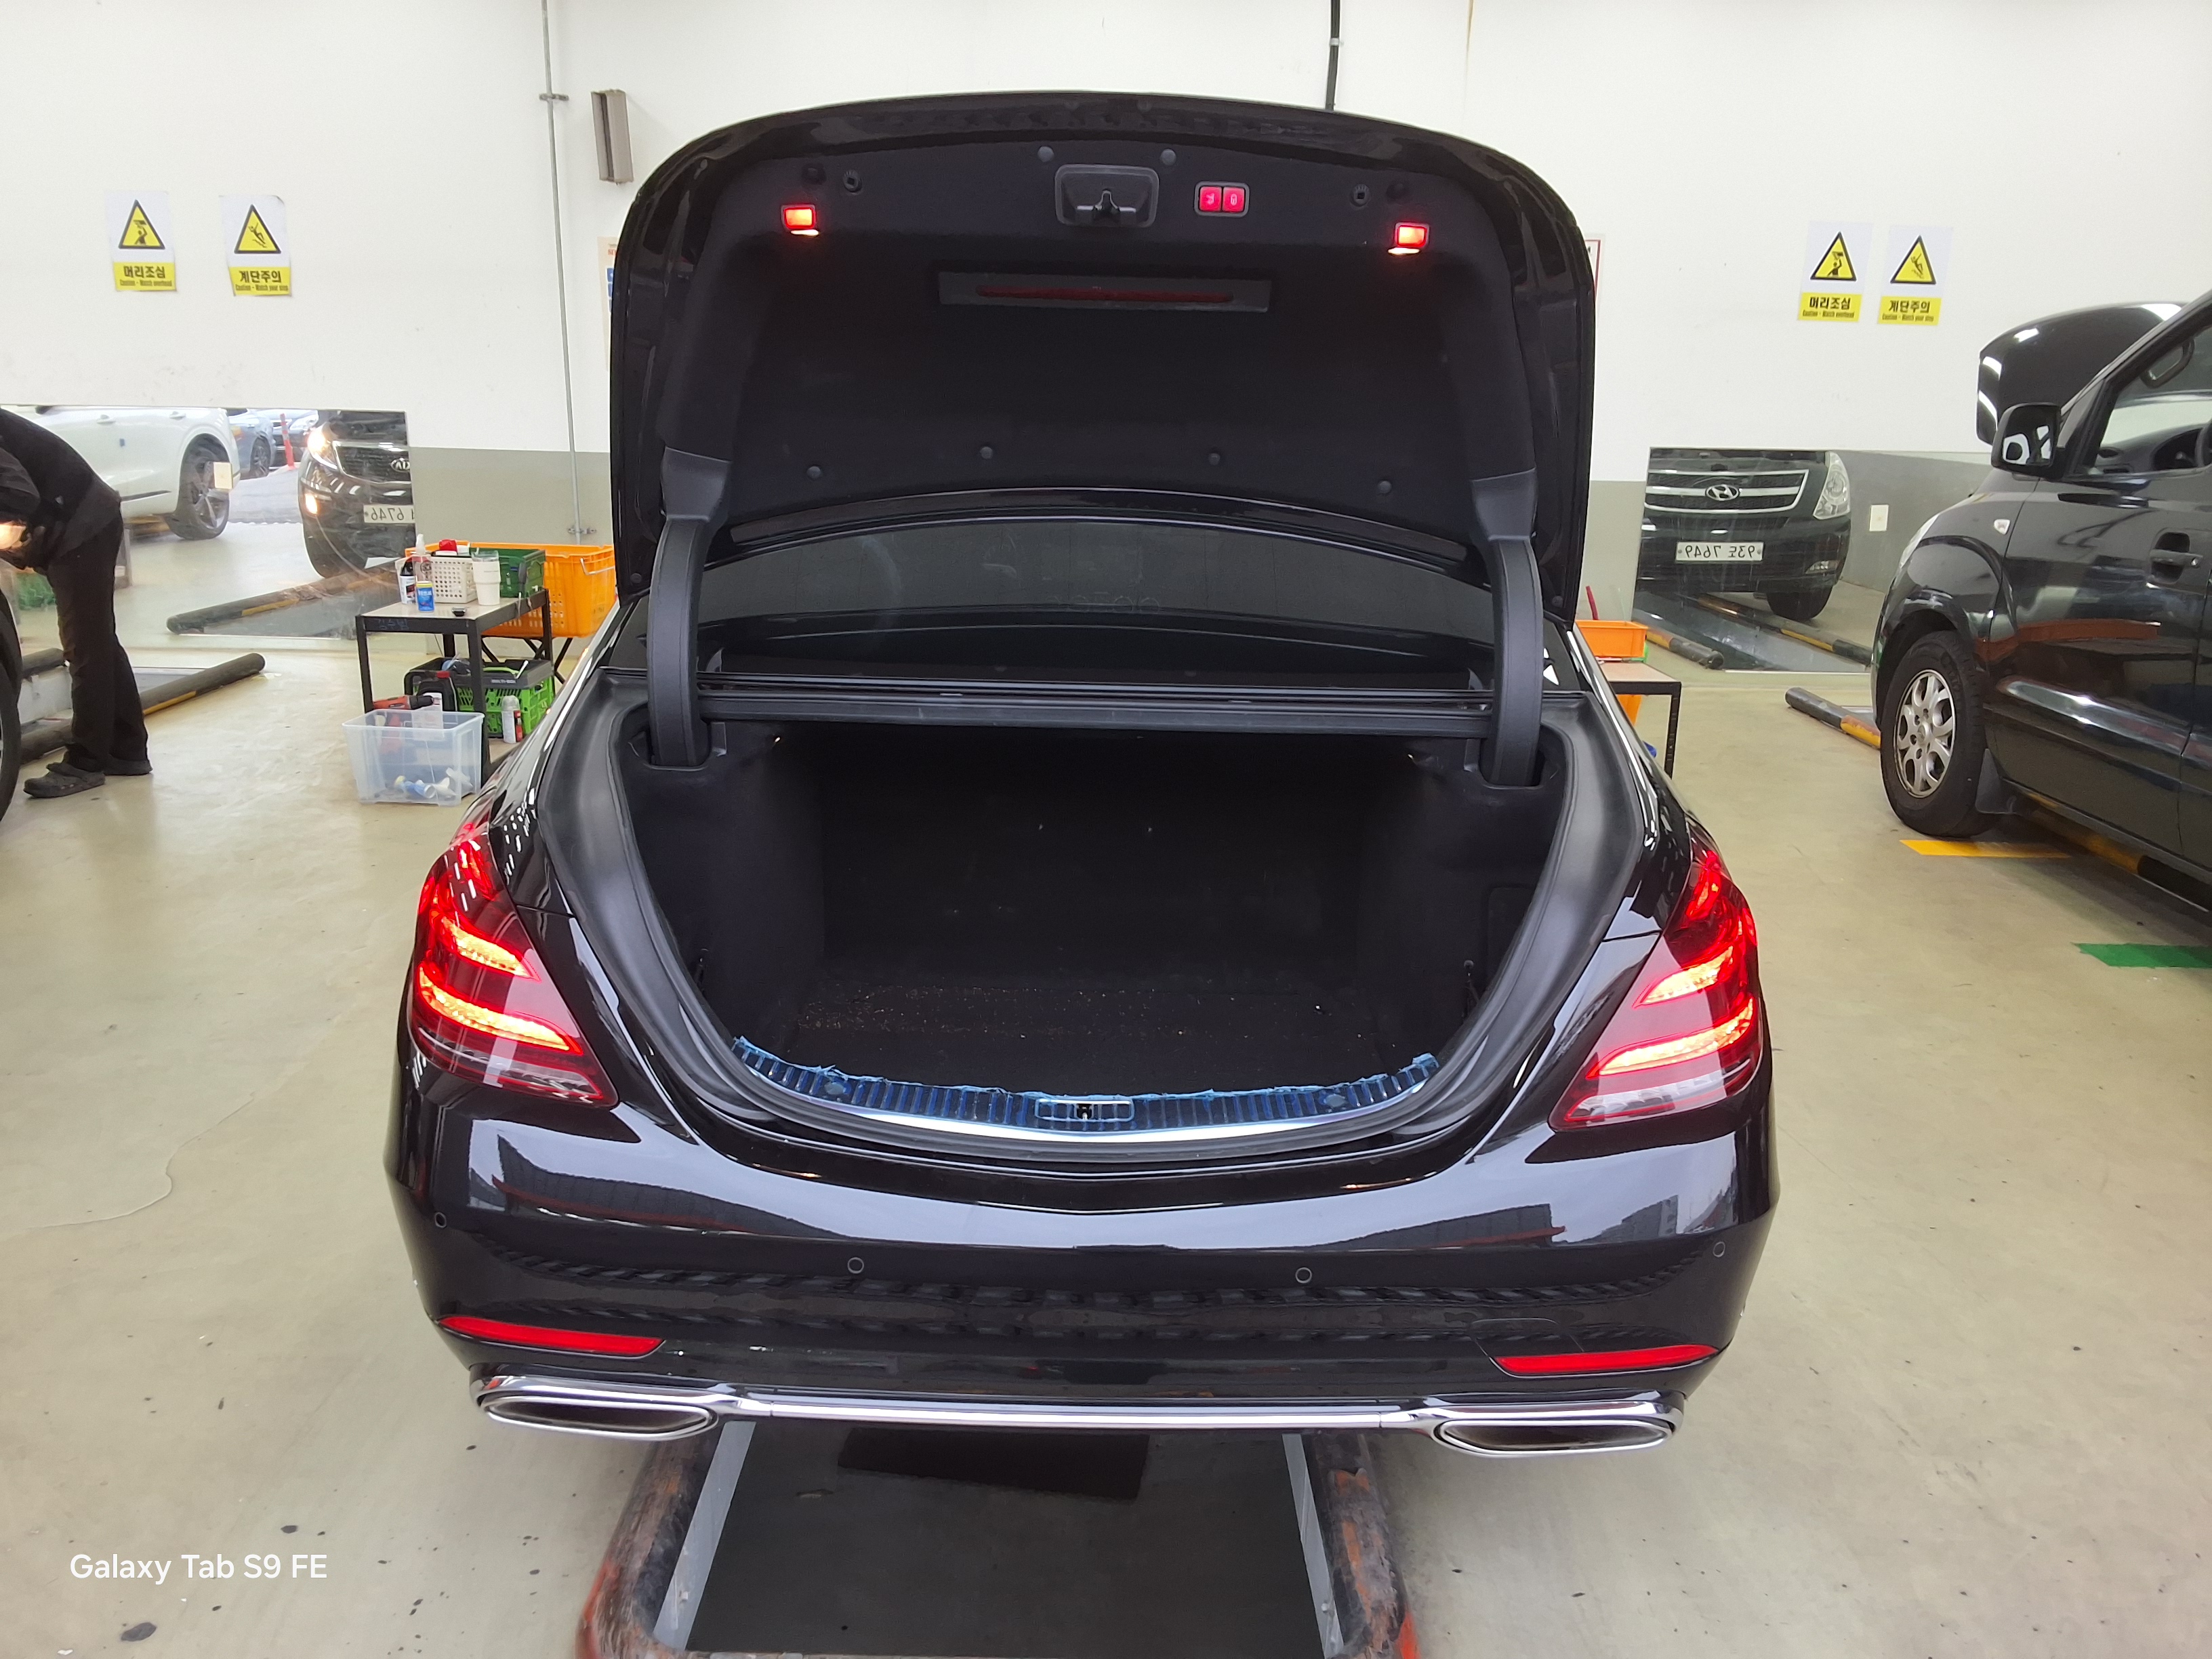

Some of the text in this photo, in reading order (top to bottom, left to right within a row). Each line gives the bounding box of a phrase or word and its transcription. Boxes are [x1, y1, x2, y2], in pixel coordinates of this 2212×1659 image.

[123, 265, 166, 279] 머리조심
[239, 270, 282, 283] 계단주의
[1809, 296, 1851, 310] 머리조심
[1888, 300, 1931, 313] 계단주의
